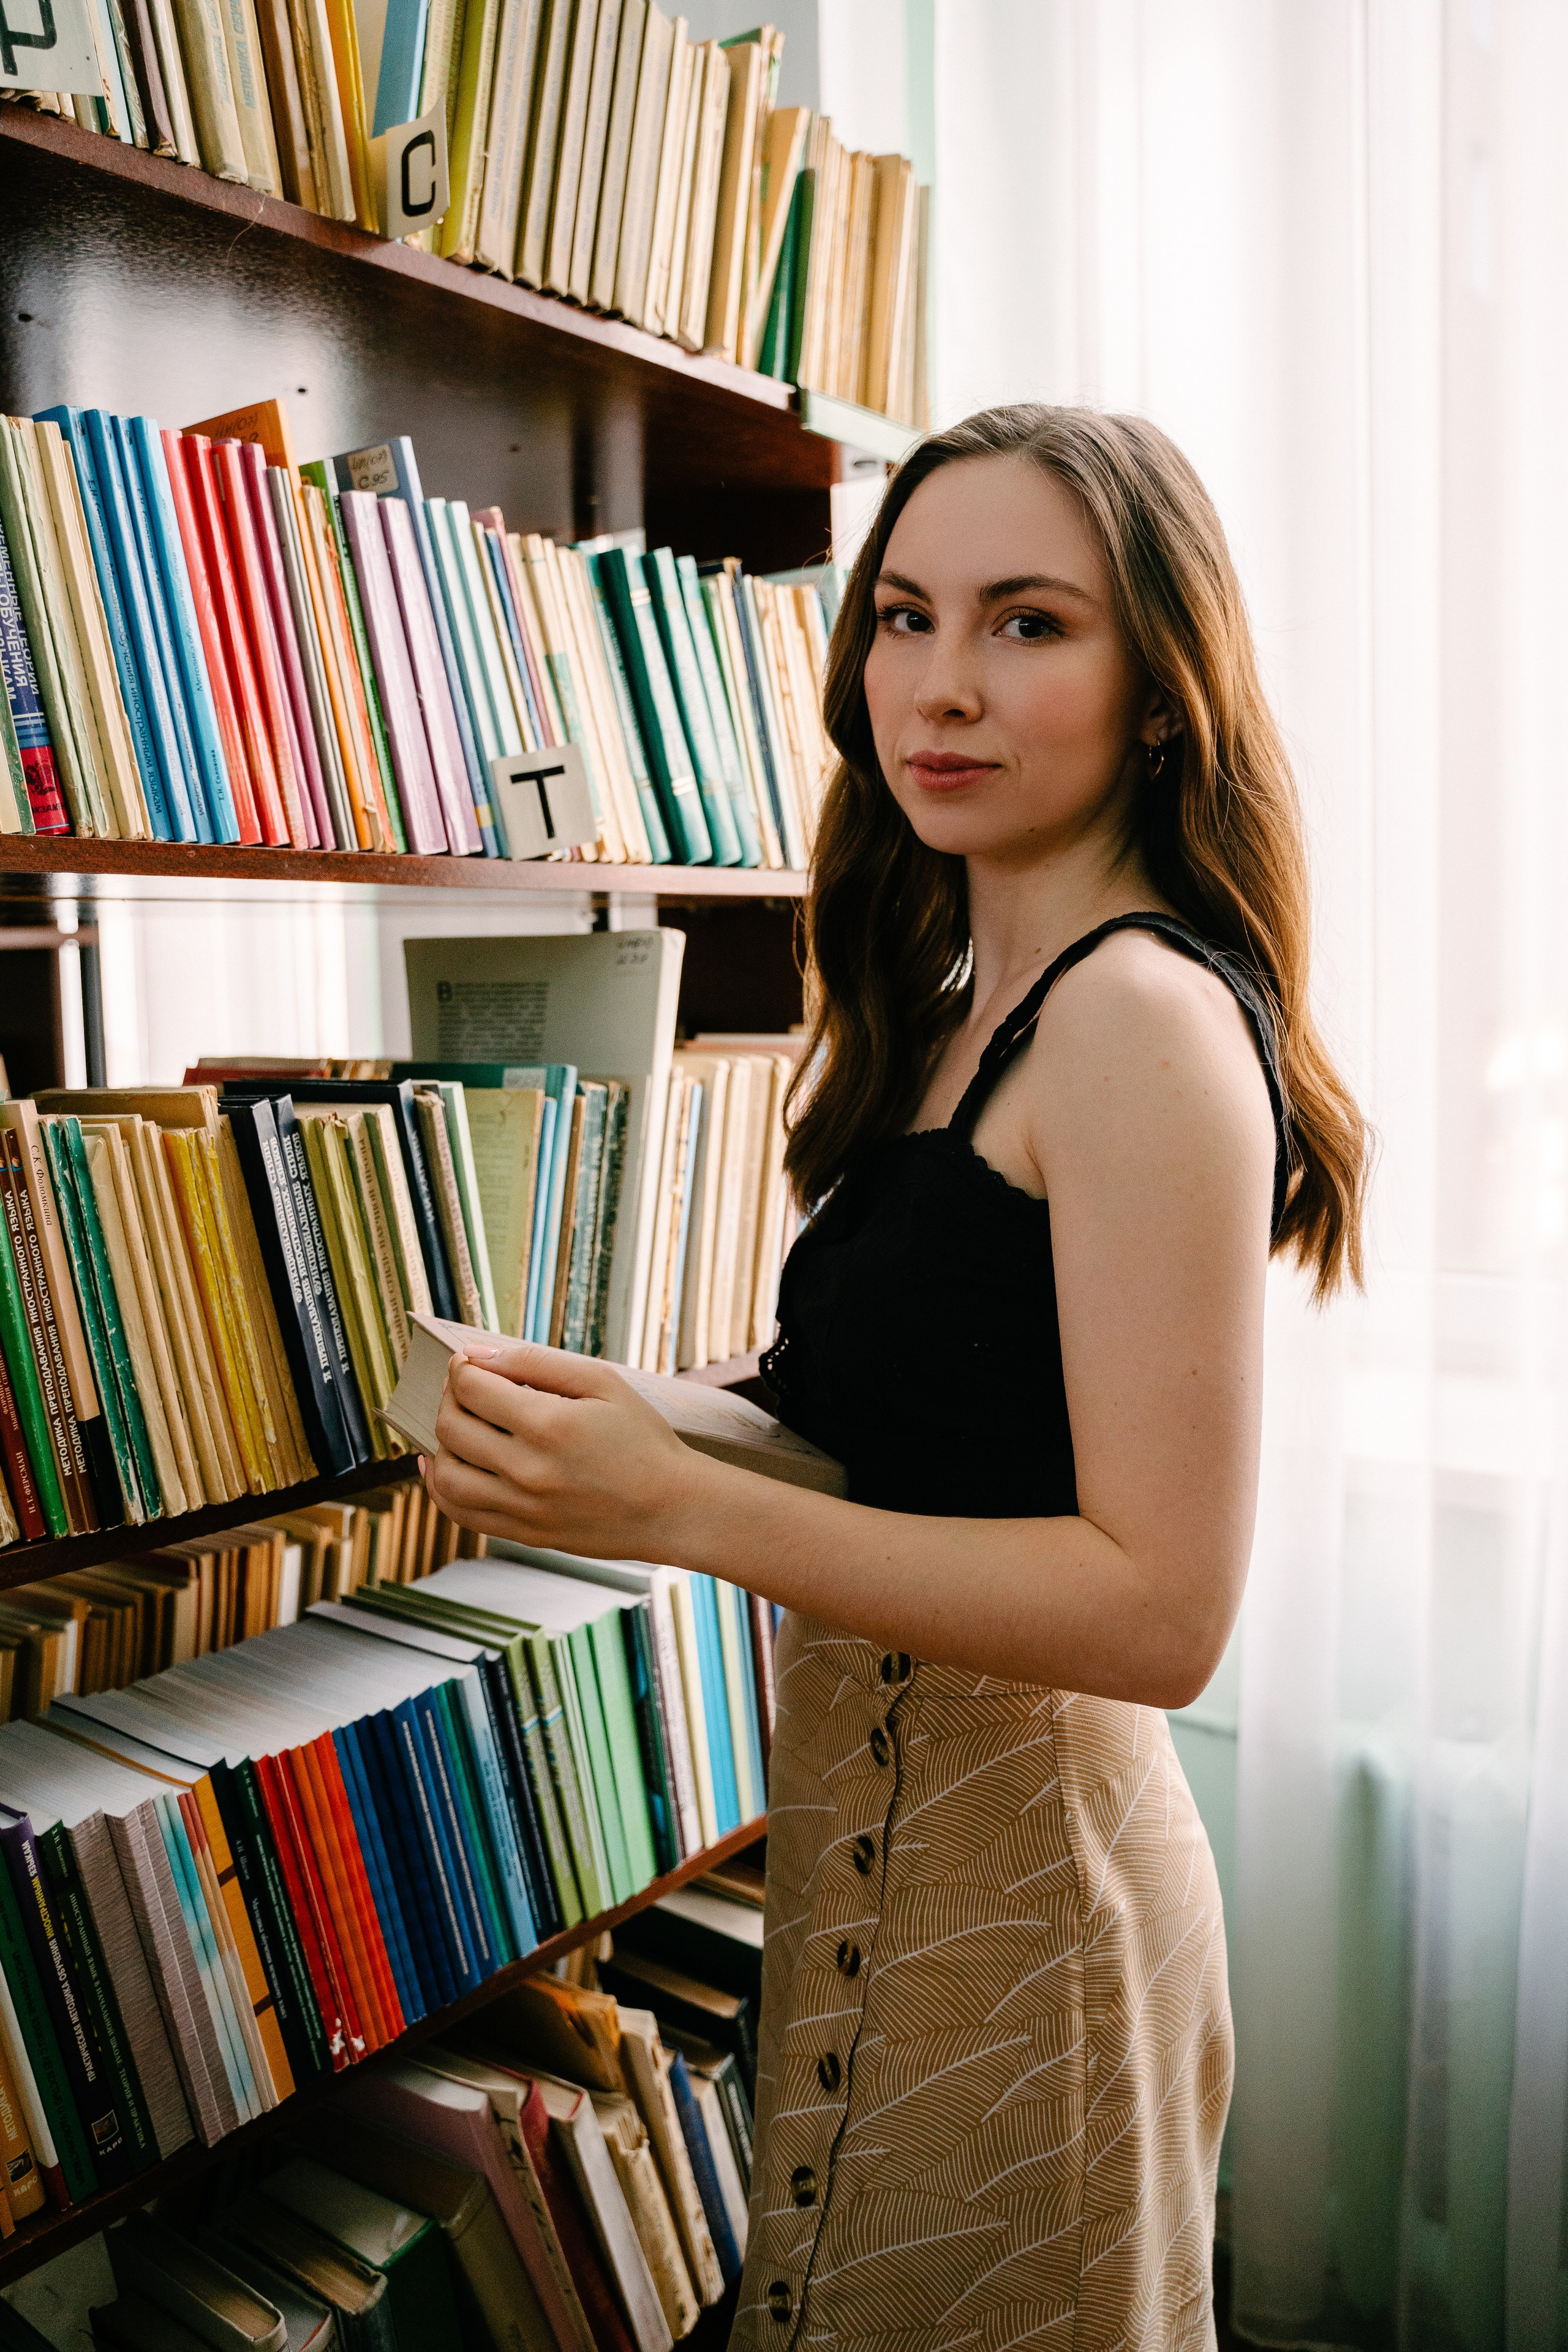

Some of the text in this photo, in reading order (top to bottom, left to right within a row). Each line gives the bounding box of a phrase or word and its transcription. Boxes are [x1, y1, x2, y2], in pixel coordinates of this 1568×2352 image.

[401, 129, 436, 217] С
[0, 592, 28, 688] ОБУЧЕНИЯ
[18, 627, 40, 695] ТЕОРИИ
[187, 644, 203, 691] Методика
[116, 625, 137, 684] обучения
[129, 686, 153, 767] иностранным
[146, 770, 162, 813] языкам
[209, 748, 221, 783] Соловова
[510, 765, 566, 839] Т
[268, 1135, 287, 1185] ЯЗЫКОВ
[290, 1132, 310, 1180] ЯЗЫКОВ
[34, 1168, 56, 1227] Фоломкина
[262, 1140, 303, 1303] ФУНКЦИОНАЛЬНЫЕ СТИЛИ
[282, 1134, 323, 1294] ФУНКЦИОНАЛЬНЫЕ СТИЛИ
[301, 1182, 329, 1269] ИНОСТРАННЫХ
[280, 1189, 309, 1277] ИНОСТРАННЫХ
[2, 1189, 74, 1476] МЕТОДИКА ПРЕПОДАВАНИЯ ИНОСТРАННОГО ЯЗЫКА
[17, 1188, 89, 1474] МЕТОДИКА ПРЕПОДАВАНИЯ ИНОСТРАННОГО ЯЗЫКА
[301, 1278, 330, 1366] ПРЕПОДАВАНИЕ
[320, 1271, 349, 1359] ПРЕПОДАВАНИЕ
[4, 1385, 20, 1431] МЫШЛЕНИЯ
[14, 1450, 32, 1495] ФЕРСМАН
[27, 1504, 36, 1513] Н.
[67, 1893, 93, 1956] ИНОСТРАННЫЙ
[20, 1839, 96, 2081] ПРАКТИЧЕСКАЯ МЕТОДИКА ОБУЧЕНИЯ ИНОСТРАННЫМ ЯЗЫКАМ
[86, 1957, 99, 1980] ЯЗЫК
[94, 1986, 116, 2035] НАЧАЛЬНОЙ
[118, 2067, 133, 2098] ТЕОРИЯ
[126, 2098, 135, 2106] И
[97, 2136, 126, 2157] КАРО
[128, 2106, 148, 2149] ПРАКТИКА
[11, 2174, 42, 2198] КАРО
